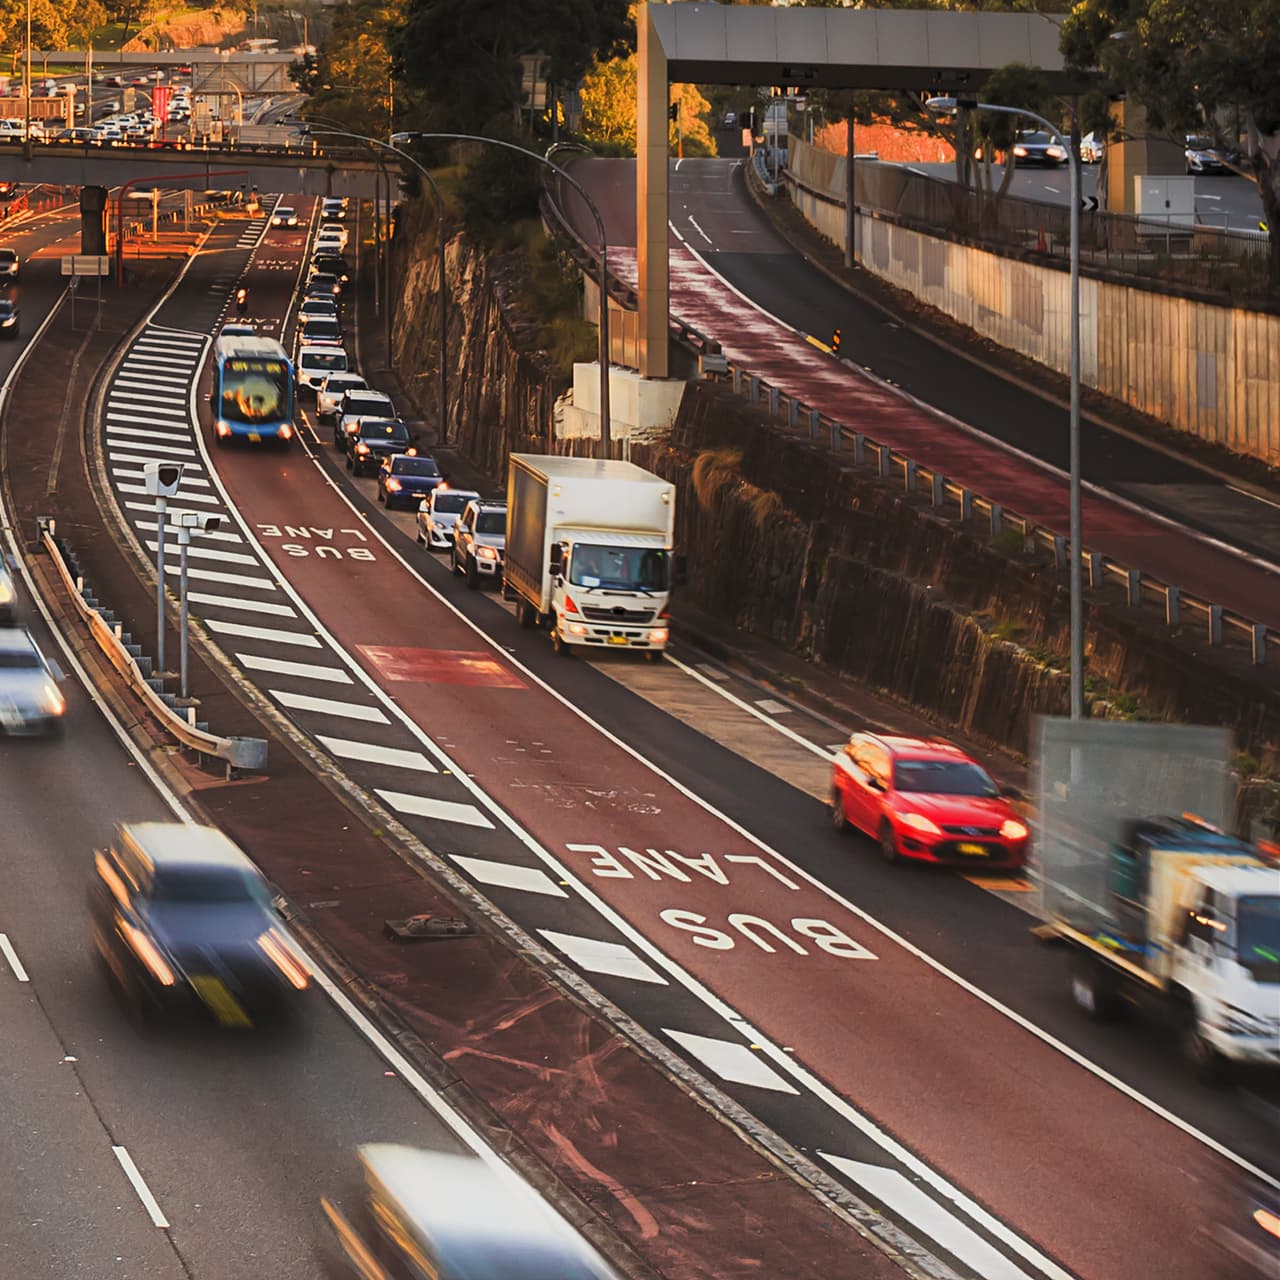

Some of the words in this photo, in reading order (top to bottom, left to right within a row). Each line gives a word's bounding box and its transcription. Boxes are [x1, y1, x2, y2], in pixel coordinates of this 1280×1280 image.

[256, 524, 368, 541] LANE
[281, 543, 377, 561] BUS
[566, 843, 801, 891] LANE
[659, 908, 880, 960] BUS
